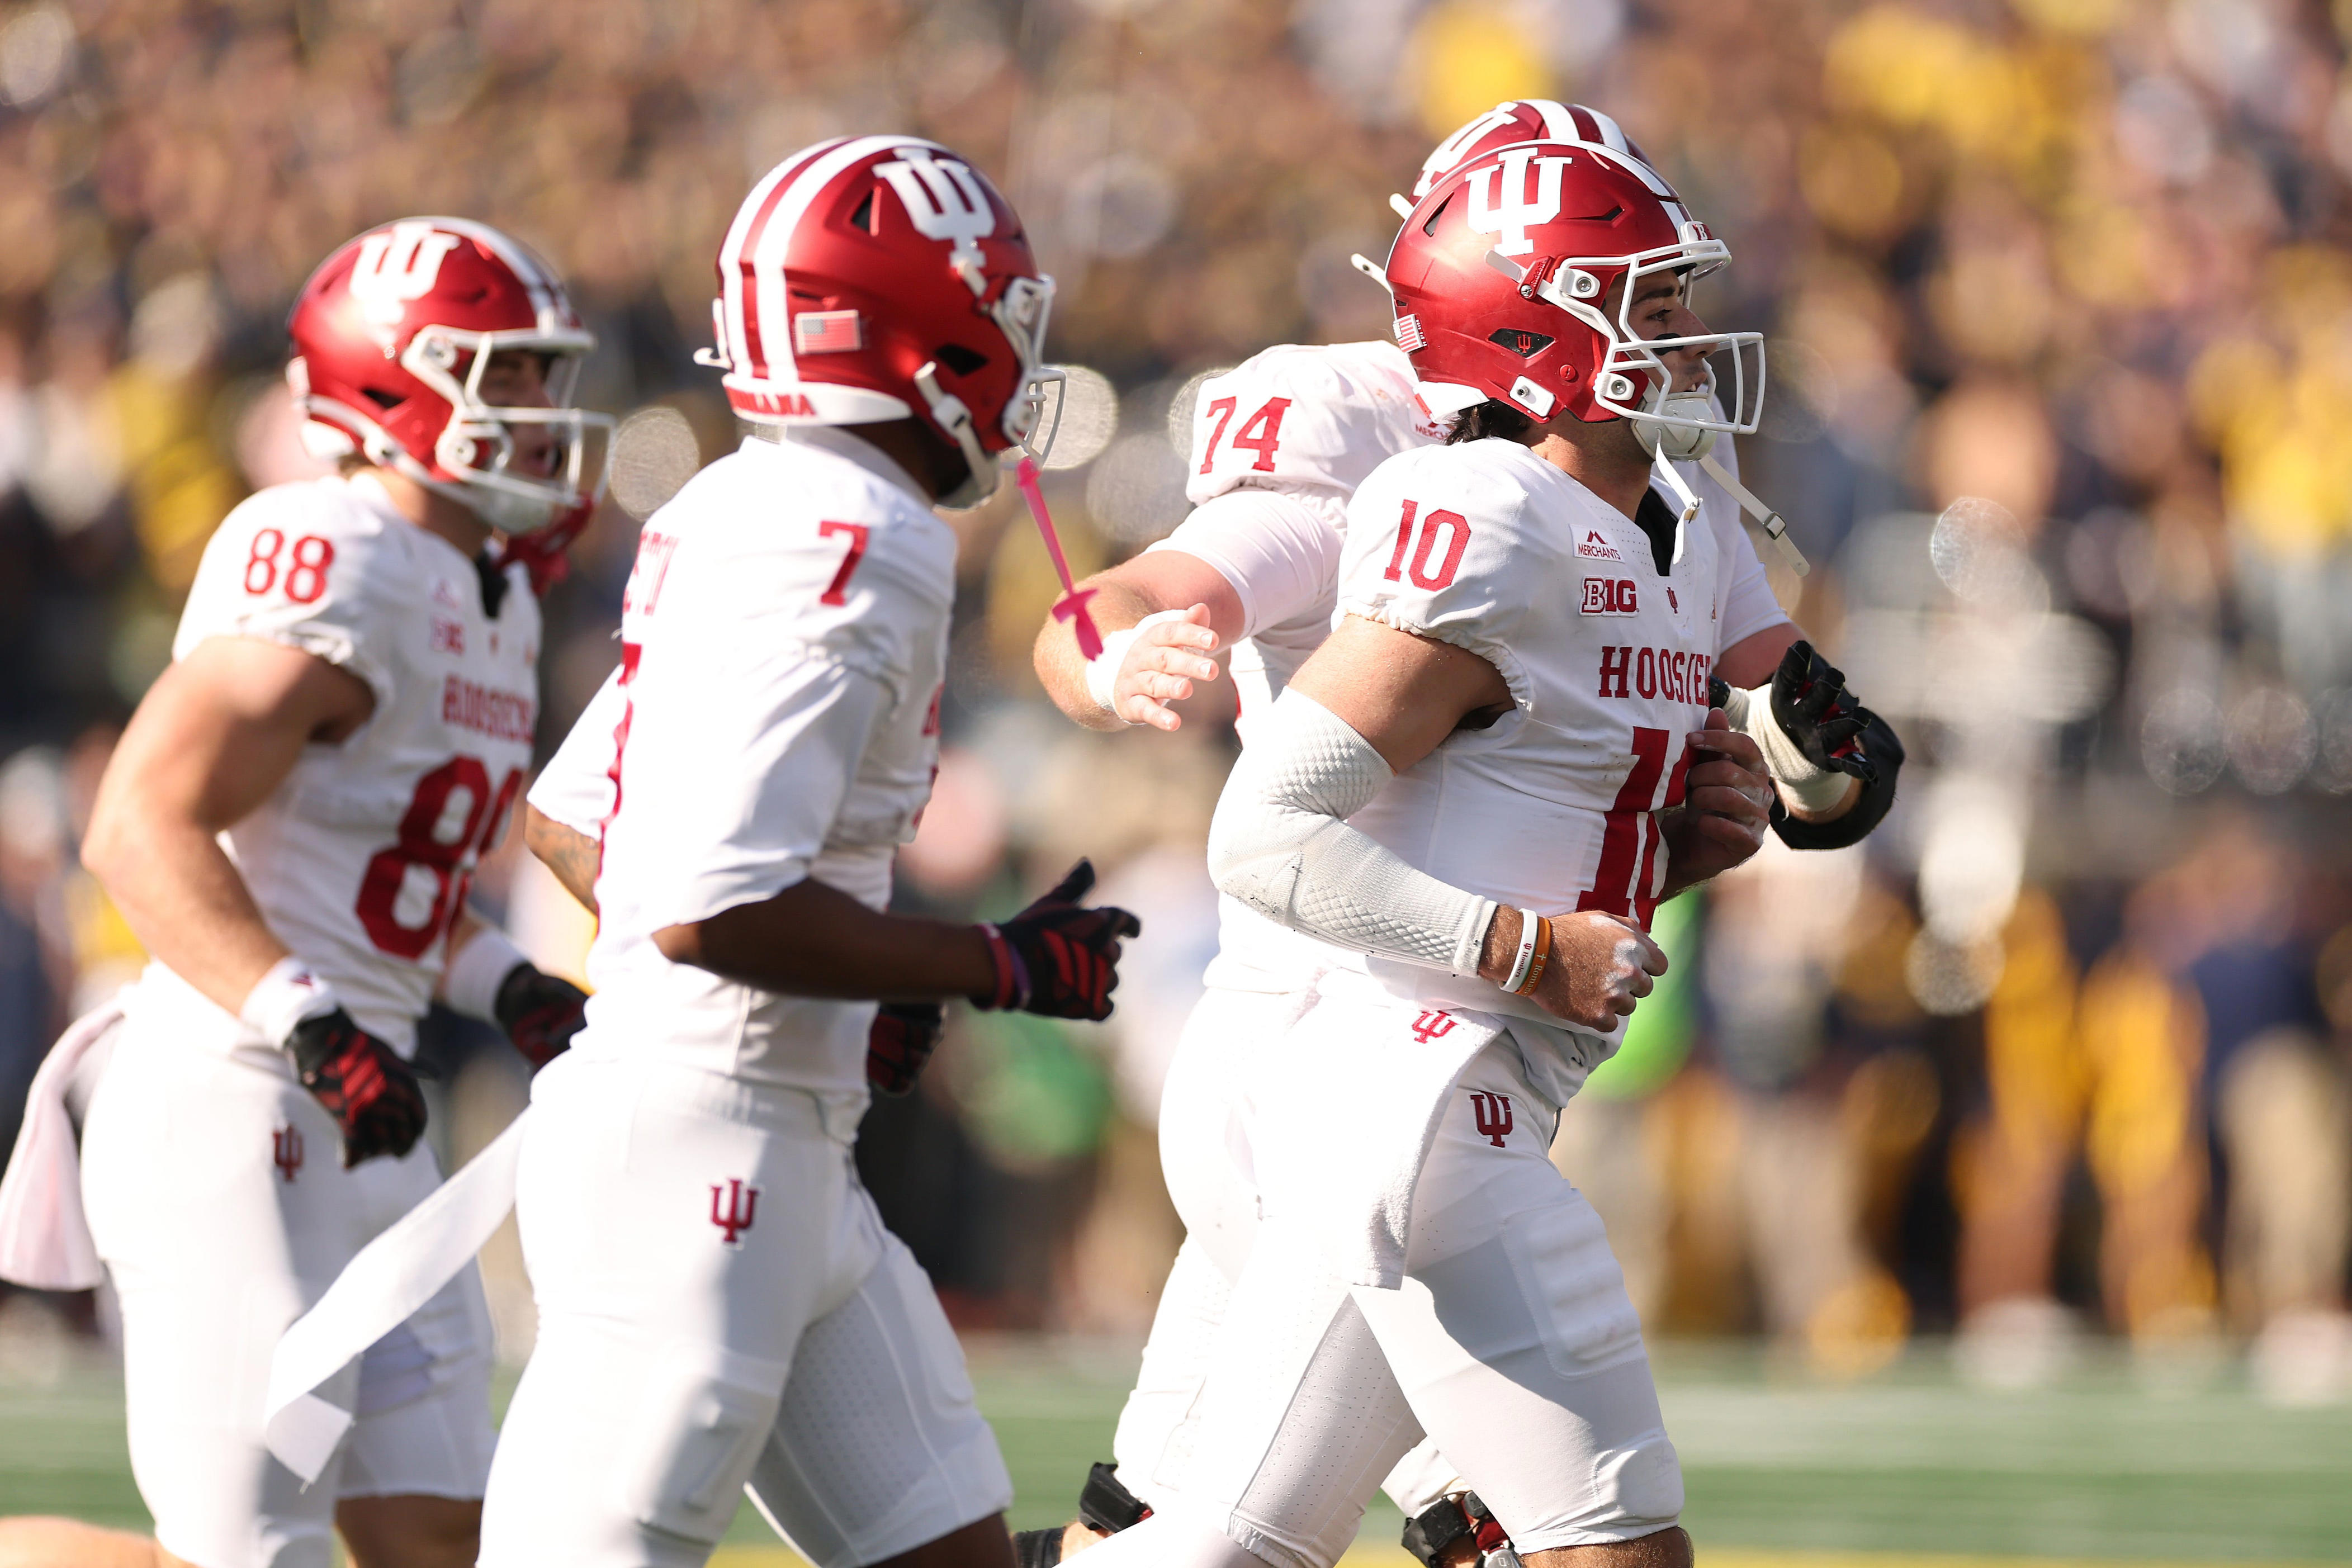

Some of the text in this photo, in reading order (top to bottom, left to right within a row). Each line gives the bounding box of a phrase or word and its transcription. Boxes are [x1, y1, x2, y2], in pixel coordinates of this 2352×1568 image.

[1199, 396, 1292, 475] 74
[244, 528, 334, 604] 88
[818, 520, 869, 606] 7
[1384, 499, 1471, 592] 10
[1578, 543, 1621, 560] MERCHANTS
[1598, 646, 1711, 708] HOOSIE
[1515, 952, 1528, 978] Hoosiers
